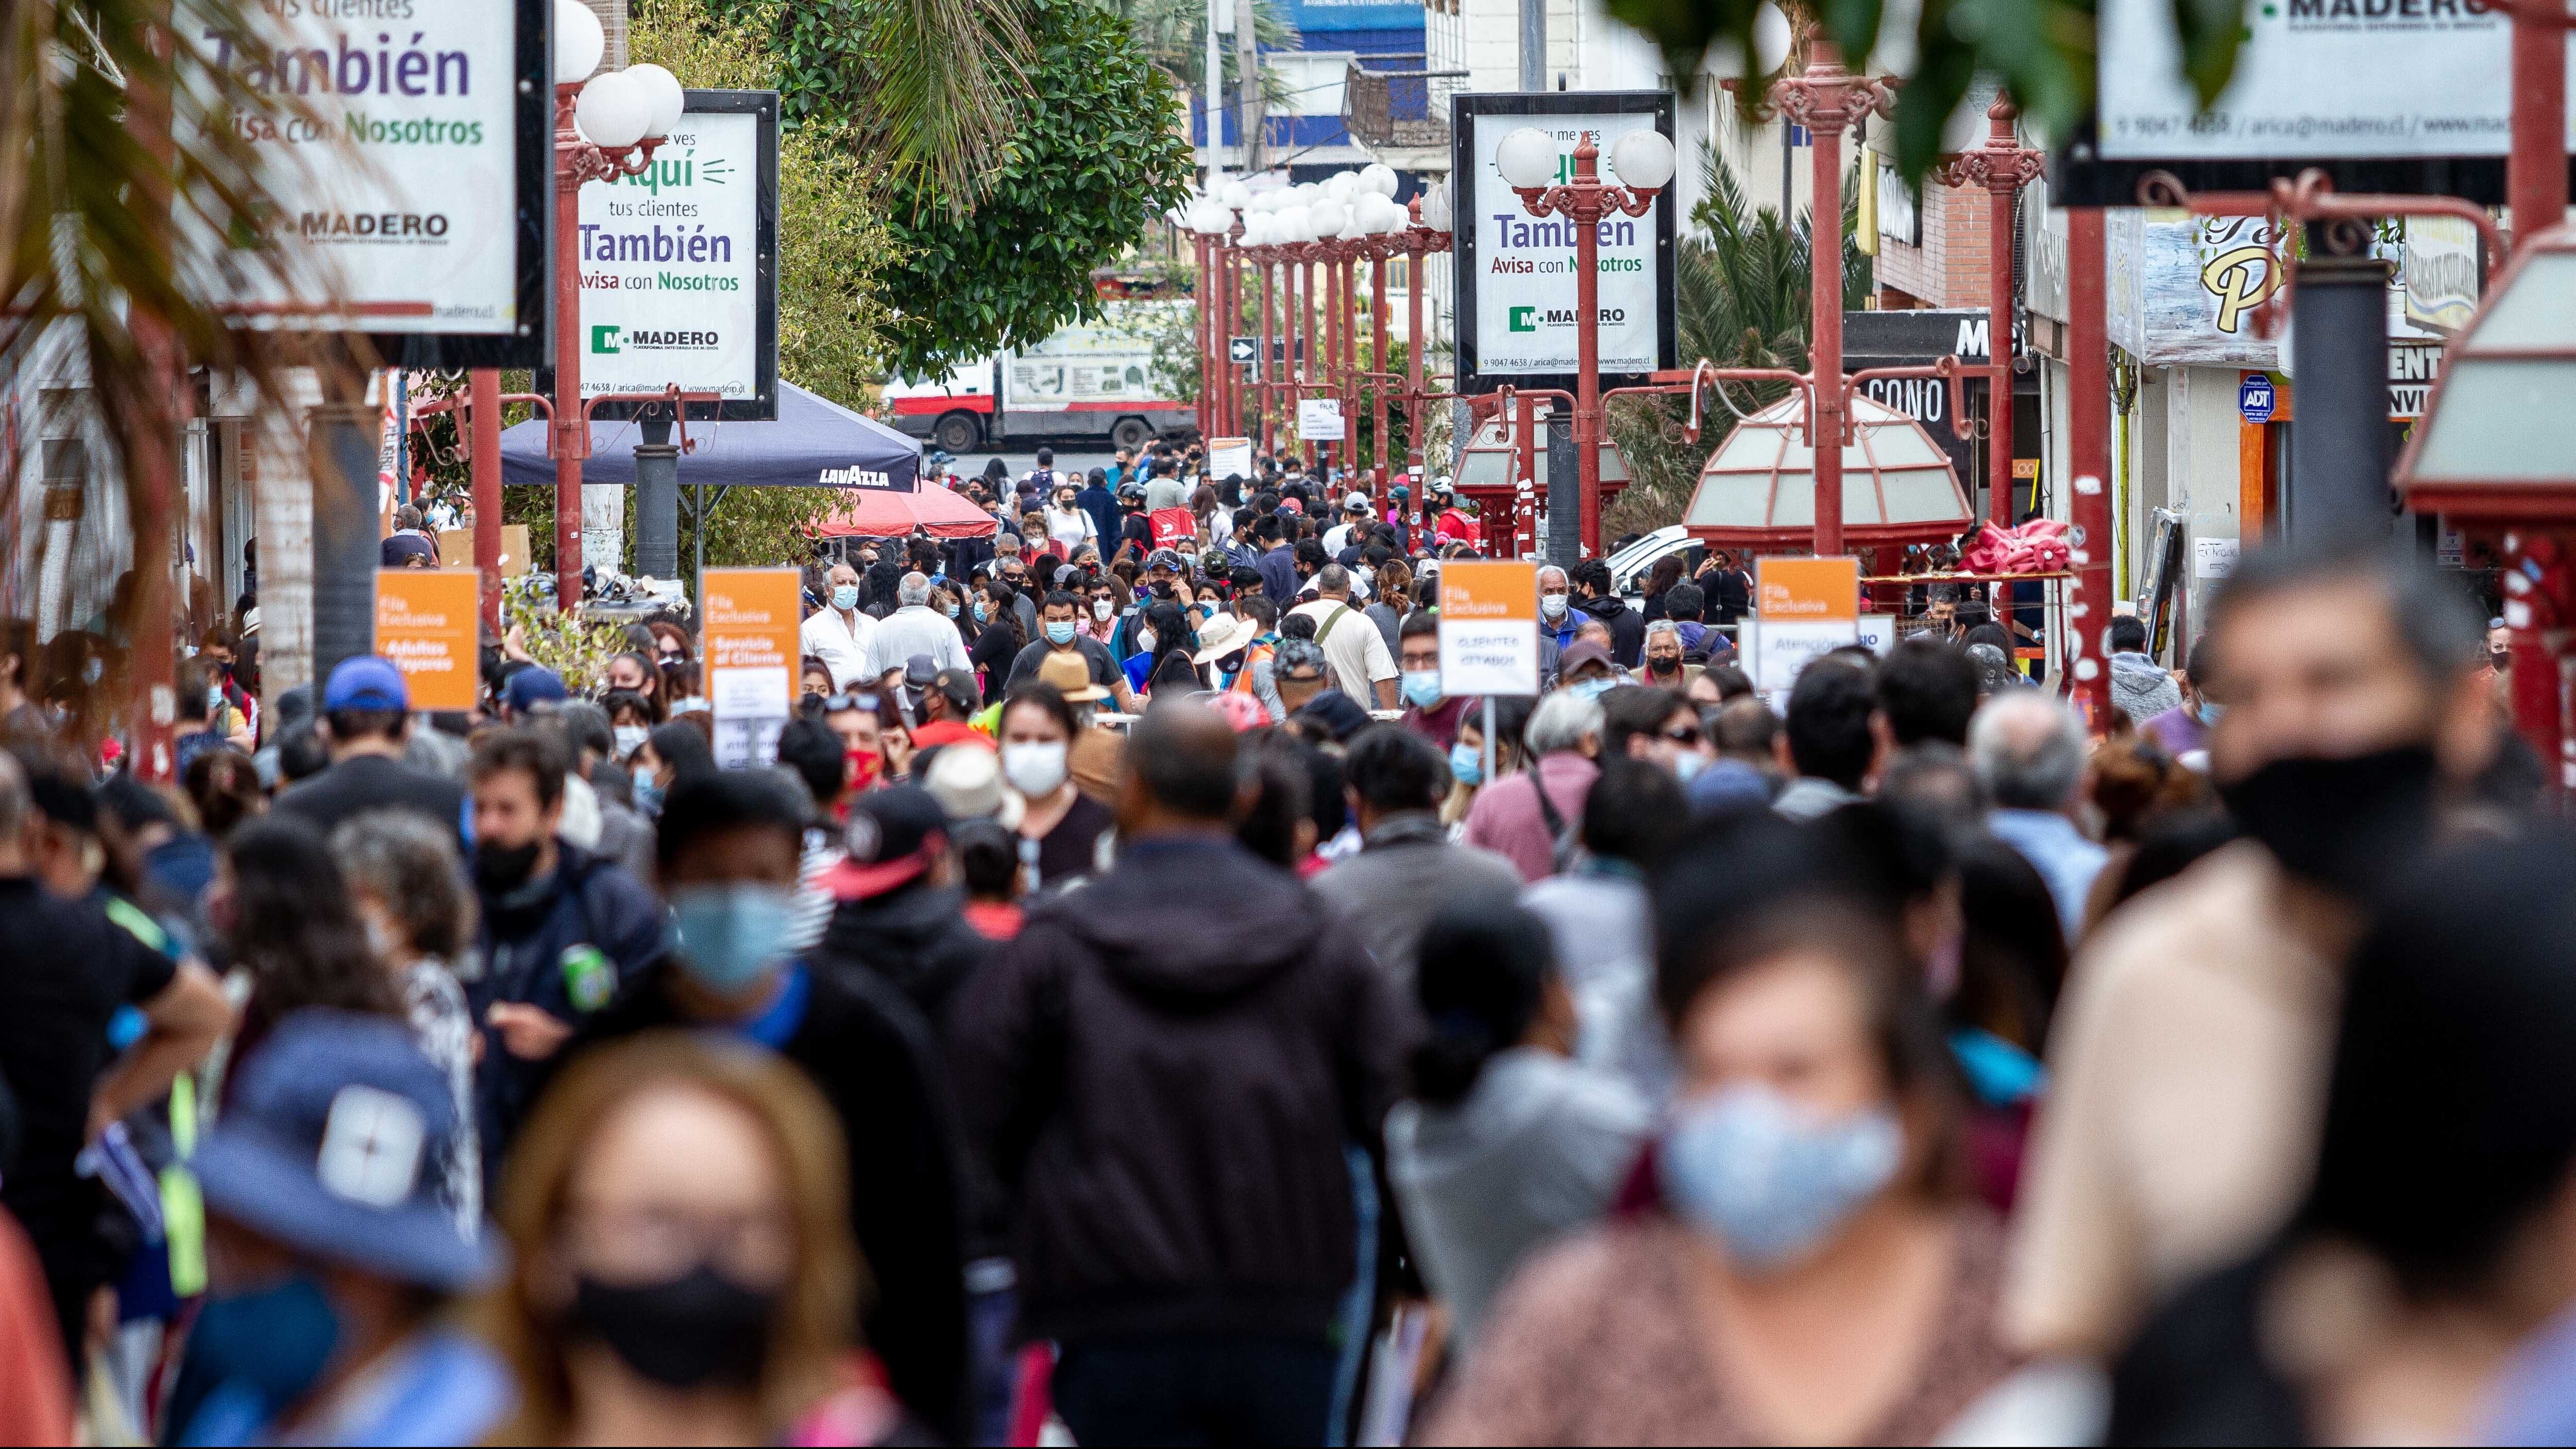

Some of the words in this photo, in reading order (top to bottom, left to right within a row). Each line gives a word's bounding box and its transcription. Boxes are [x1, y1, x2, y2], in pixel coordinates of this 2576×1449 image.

[345, 110, 483, 145] Nosotros
[1557, 131, 1576, 141] me
[1580, 130, 1601, 141] es
[673, 134, 696, 145] ves
[609, 200, 632, 216] tus
[638, 200, 698, 217] clientes
[300, 213, 448, 236] MADERO
[579, 224, 731, 263] También
[1491, 256, 1534, 274] Avisa
[1538, 261, 1564, 274] con
[1569, 255, 1642, 272] Notros
[624, 276, 652, 289] con
[658, 271, 739, 291] Nosotros
[1547, 309, 1625, 322] MARO
[633, 331, 719, 345] MADERO
[1490, 359, 1508, 367] 9047
[1510, 359, 1527, 367] 4638
[1534, 358, 1579, 367] arica@made
[2387, 348, 2443, 380] ENT
[591, 383, 610, 392] 4638
[2245, 390, 2270, 407] ADT
[819, 465, 890, 487] LAVAZZA
[395, 656, 454, 674] ayores
